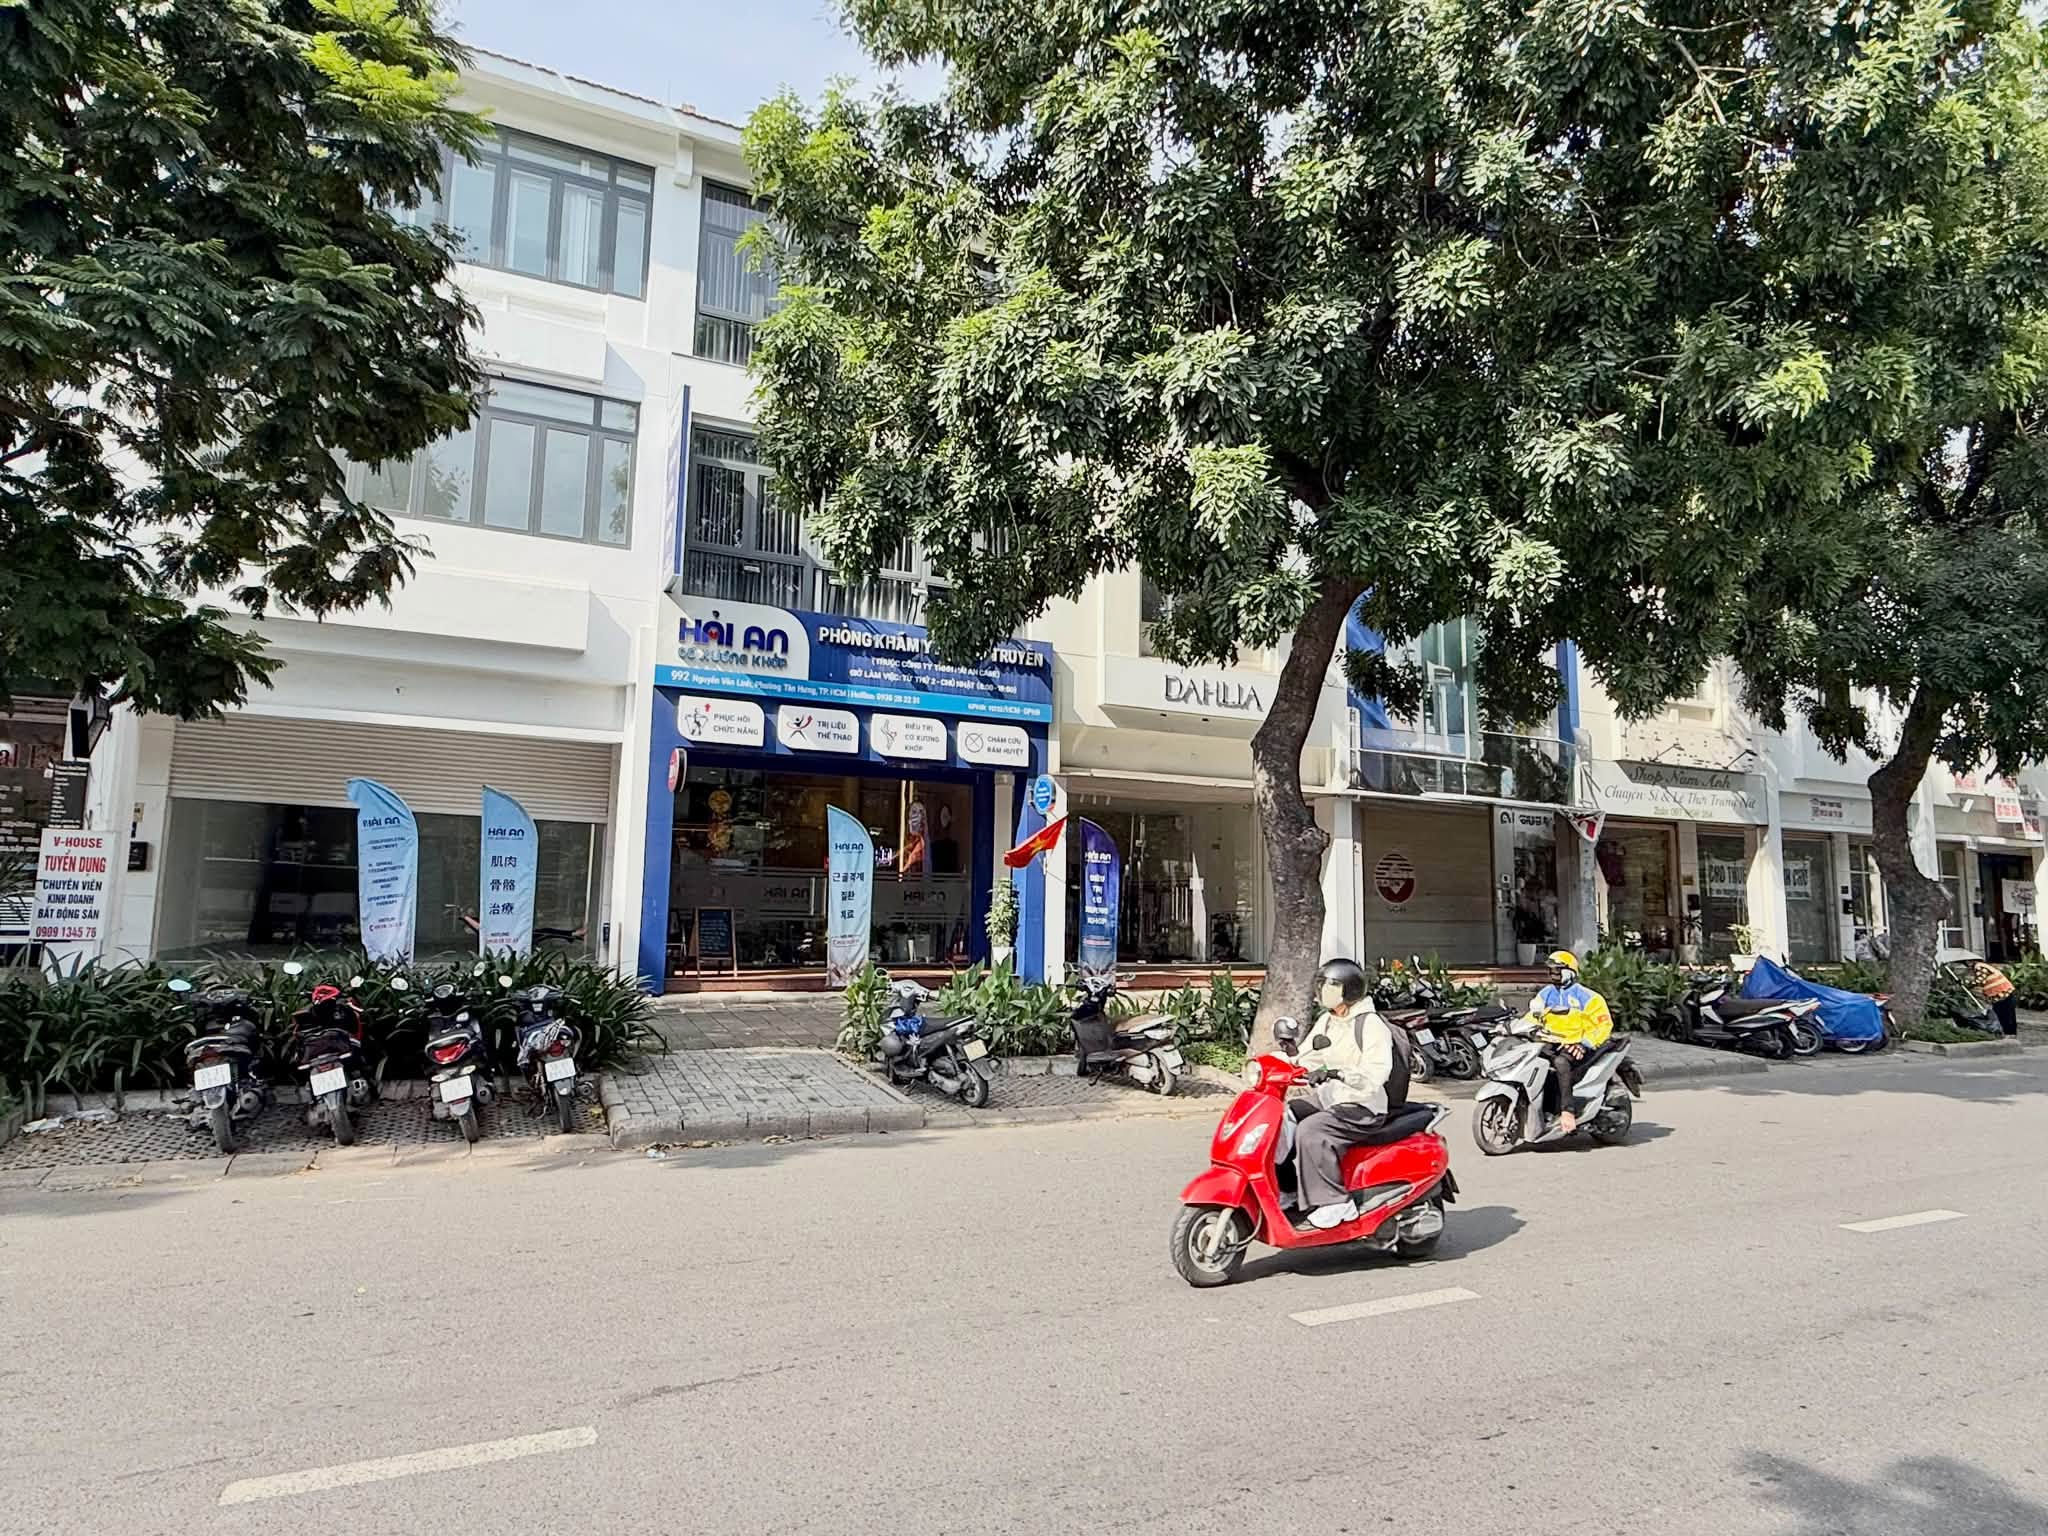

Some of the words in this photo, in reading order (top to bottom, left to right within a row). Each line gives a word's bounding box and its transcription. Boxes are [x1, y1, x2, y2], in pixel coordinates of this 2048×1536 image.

[818, 622, 872, 649] PHÒNG
[751, 653, 788, 670] KHỚP
[923, 662, 933, 671] TY
[671, 669, 690, 682] 992
[864, 669, 881, 679] LÀM
[1164, 674, 1264, 712] DAHLIA
[713, 713, 735, 724] PHỤC
[713, 724, 735, 734] CHỨC
[816, 720, 829, 730] TRỊ
[831, 720, 847, 731] LIỆU
[833, 733, 852, 742] THAO
[1630, 766, 1663, 786] Shop
[1666, 769, 1698, 786] Nam
[1703, 773, 1730, 789] Anh
[54, 836, 103, 849] V-HOUSE
[45, 849, 77, 873] TUYỂN
[79, 856, 107, 877] DỤNG
[490, 855, 517, 868] 肌肉
[43, 878, 80, 891] CHUYÊN
[82, 879, 103, 891] VIÊN
[48, 893, 67, 905] KINH
[68, 894, 95, 905] DOANH
[38, 905, 55, 919] BẤT
[56, 907, 80, 922] ĐỘNG
[488, 902, 514, 915] 治療
